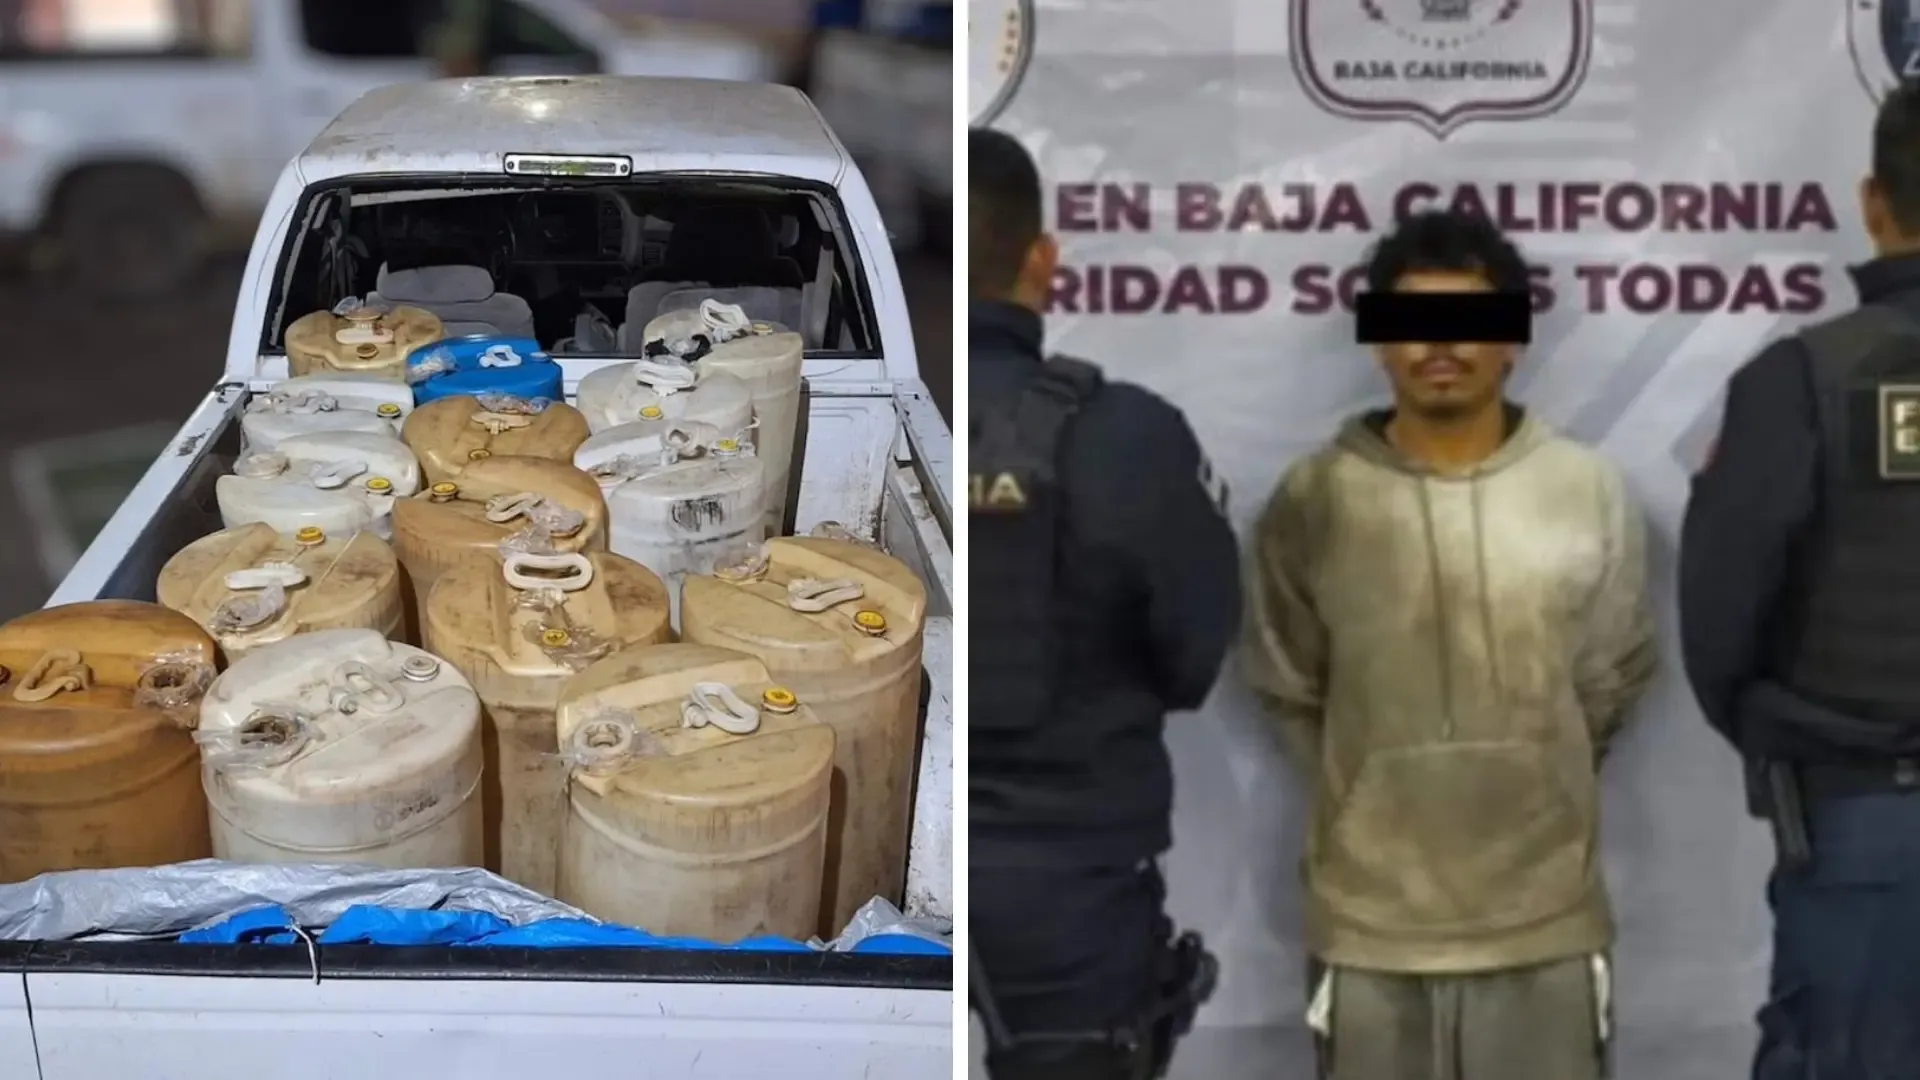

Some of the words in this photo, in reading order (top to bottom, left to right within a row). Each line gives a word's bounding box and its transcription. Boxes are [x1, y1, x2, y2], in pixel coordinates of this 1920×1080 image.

[1333, 61, 1396, 79] BAJA
[1404, 61, 1548, 79] CALIFORNIA
[1057, 183, 1150, 232] EN
[1177, 183, 1371, 232] BAJA
[1394, 182, 1836, 232] CALIFORNIA
[1574, 264, 1826, 314] TODAS
